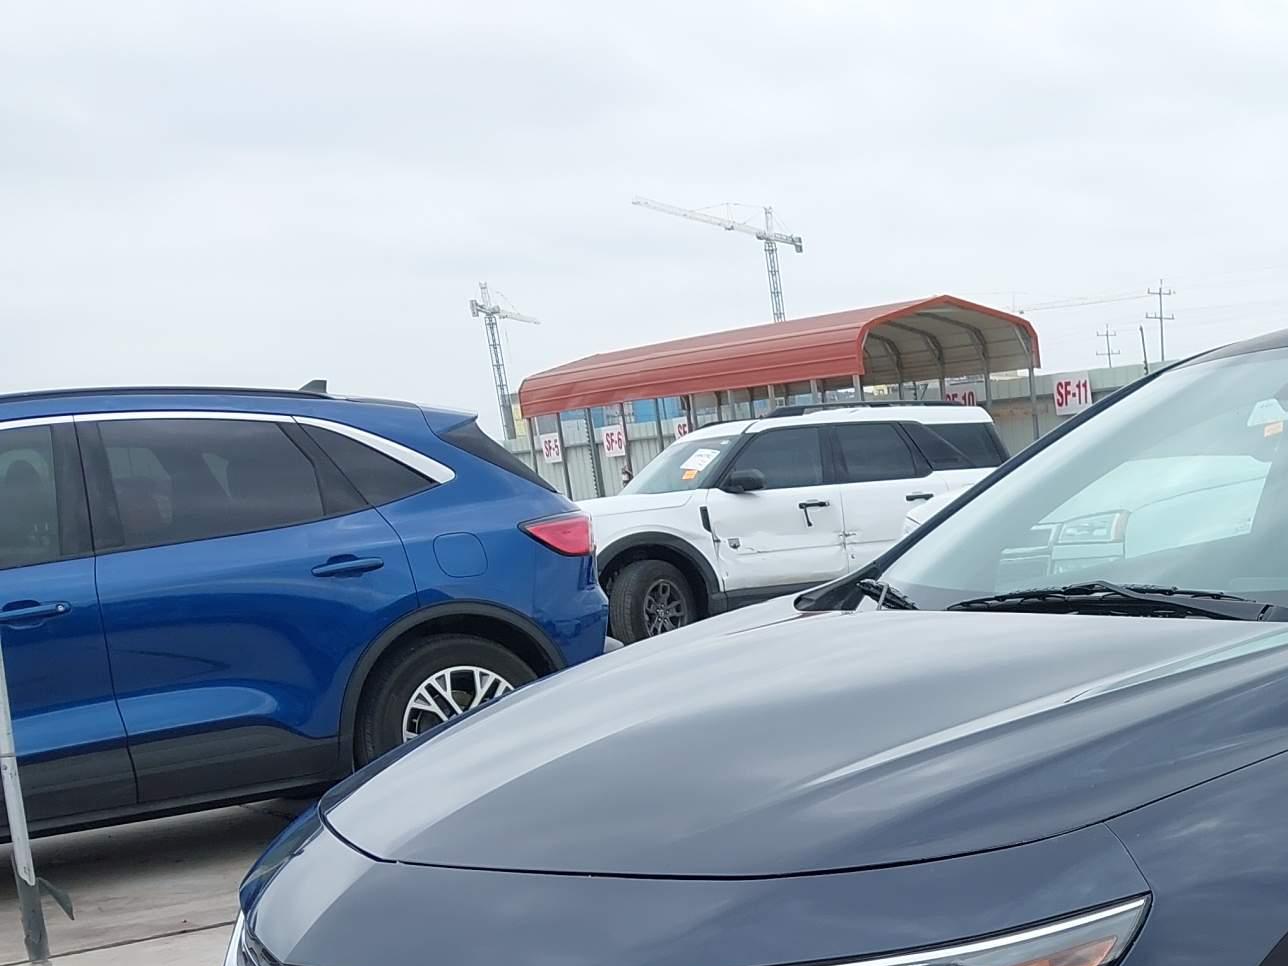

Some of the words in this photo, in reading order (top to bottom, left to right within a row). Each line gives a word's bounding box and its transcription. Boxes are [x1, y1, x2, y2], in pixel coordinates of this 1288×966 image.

[1056, 380, 1088, 407] SF-11
[544, 439, 560, 457] SF-5
[605, 432, 623, 451] SF-6
